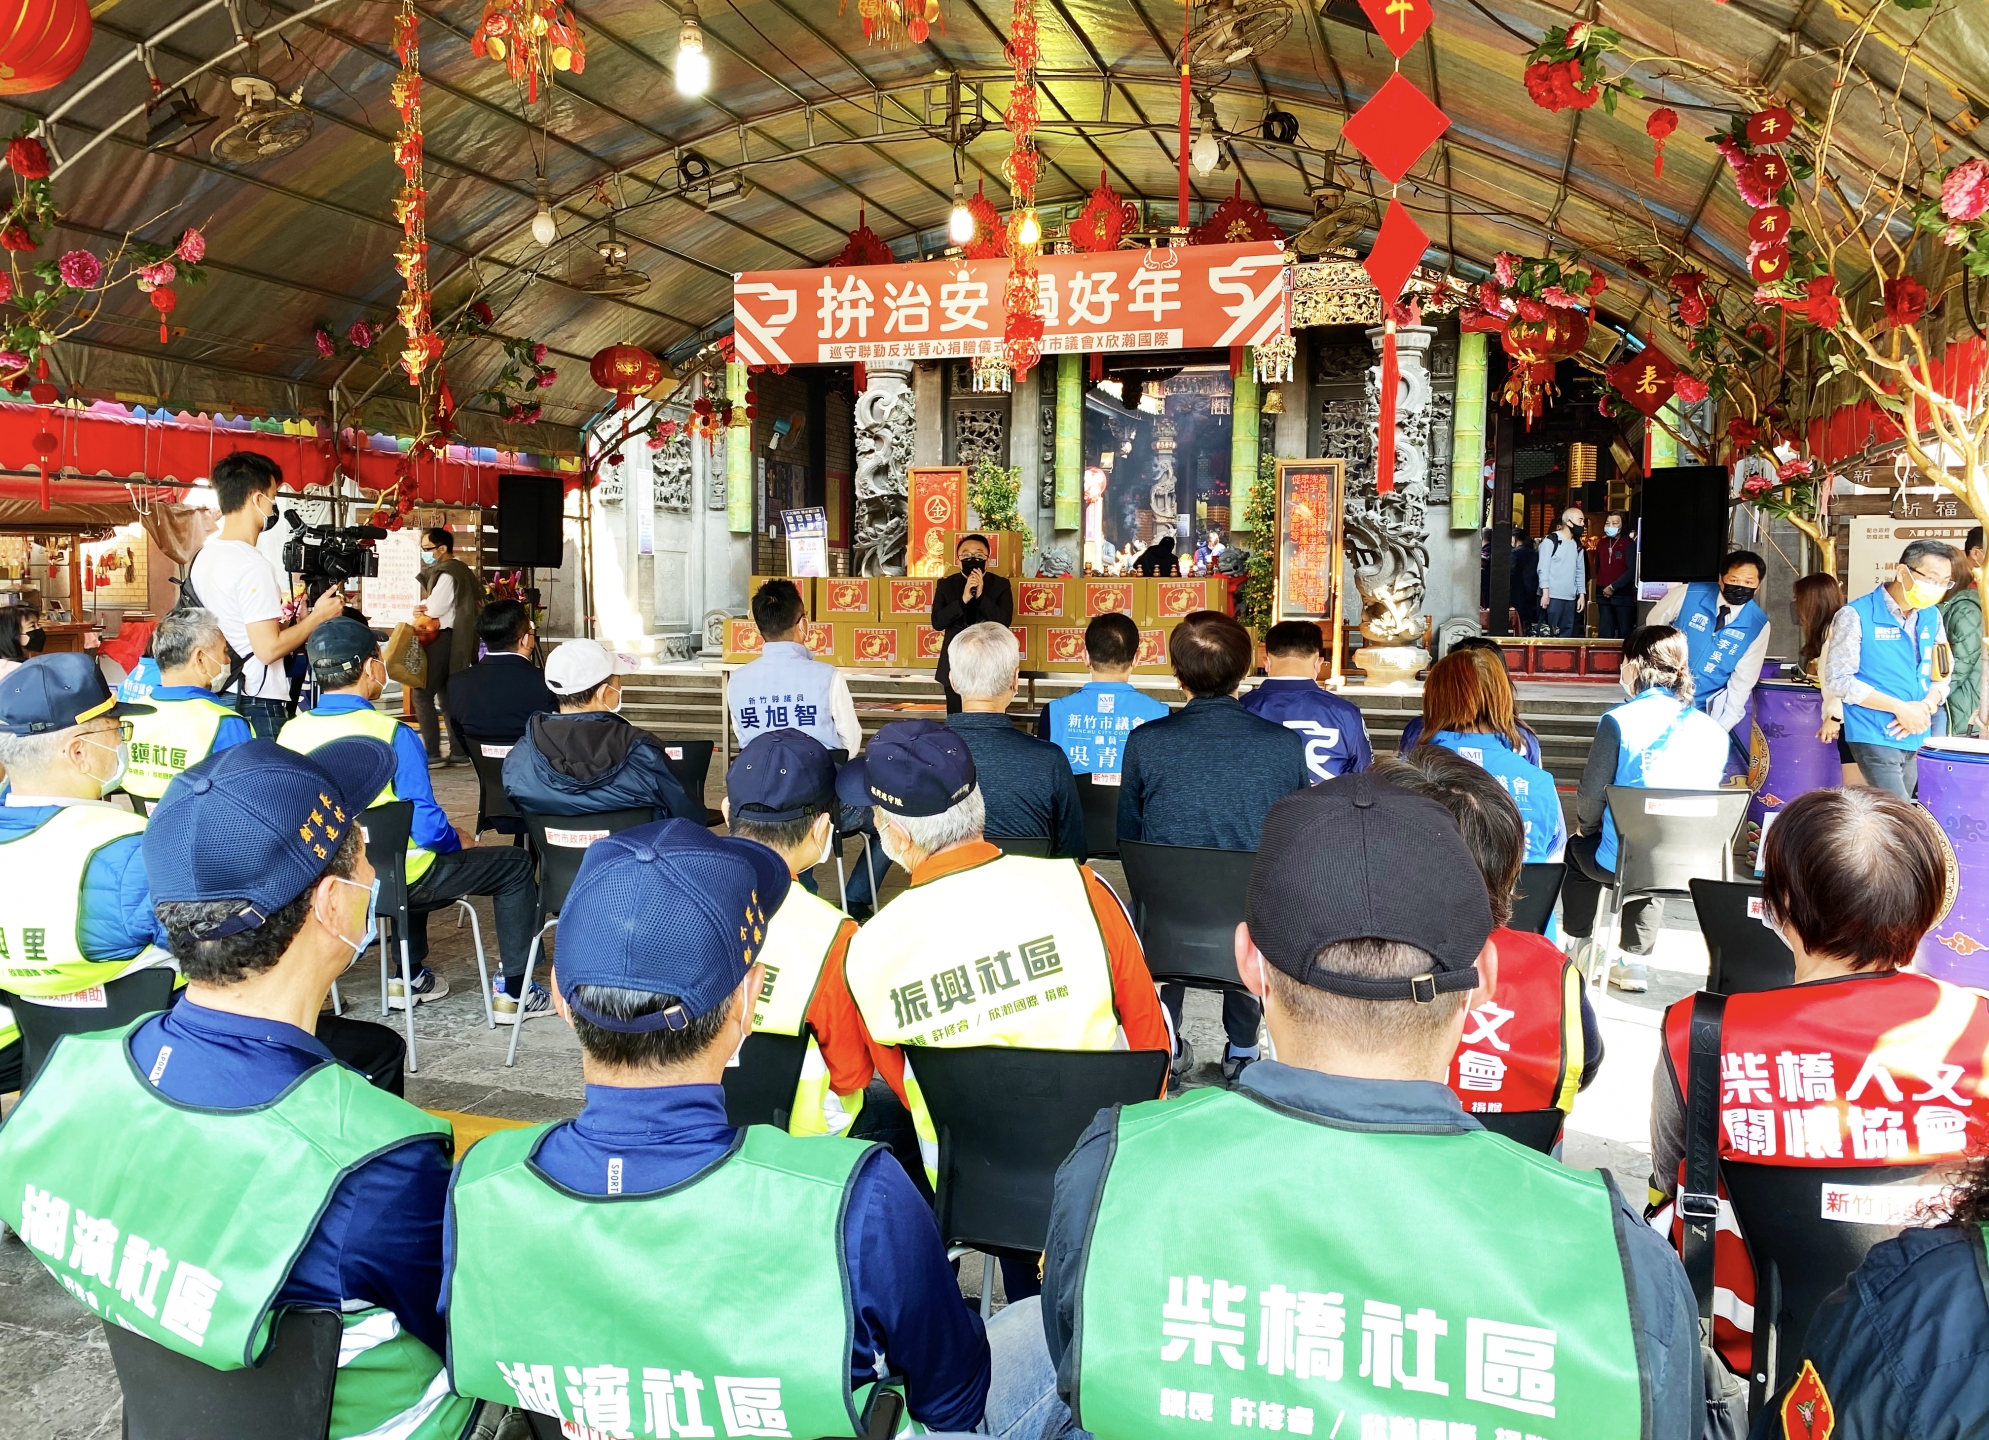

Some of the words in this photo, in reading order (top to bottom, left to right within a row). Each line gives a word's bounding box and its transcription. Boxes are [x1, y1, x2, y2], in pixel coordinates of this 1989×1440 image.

[928, 498, 947, 519] 金
[740, 704, 818, 729] 吳旭智
[1461, 750, 1482, 759] KMT
[889, 934, 1064, 1030] 振興社區
[1462, 1000, 1515, 1052] 文
[154, 1051, 168, 1076] SPORT
[1720, 1050, 1974, 1107] 柴橋人文
[610, 1164, 620, 1193] SPORT
[20, 1183, 224, 1348] 湖濱社區
[1160, 1274, 1558, 1418] 柴橋社區
[496, 1360, 793, 1439] 湖濱社區
